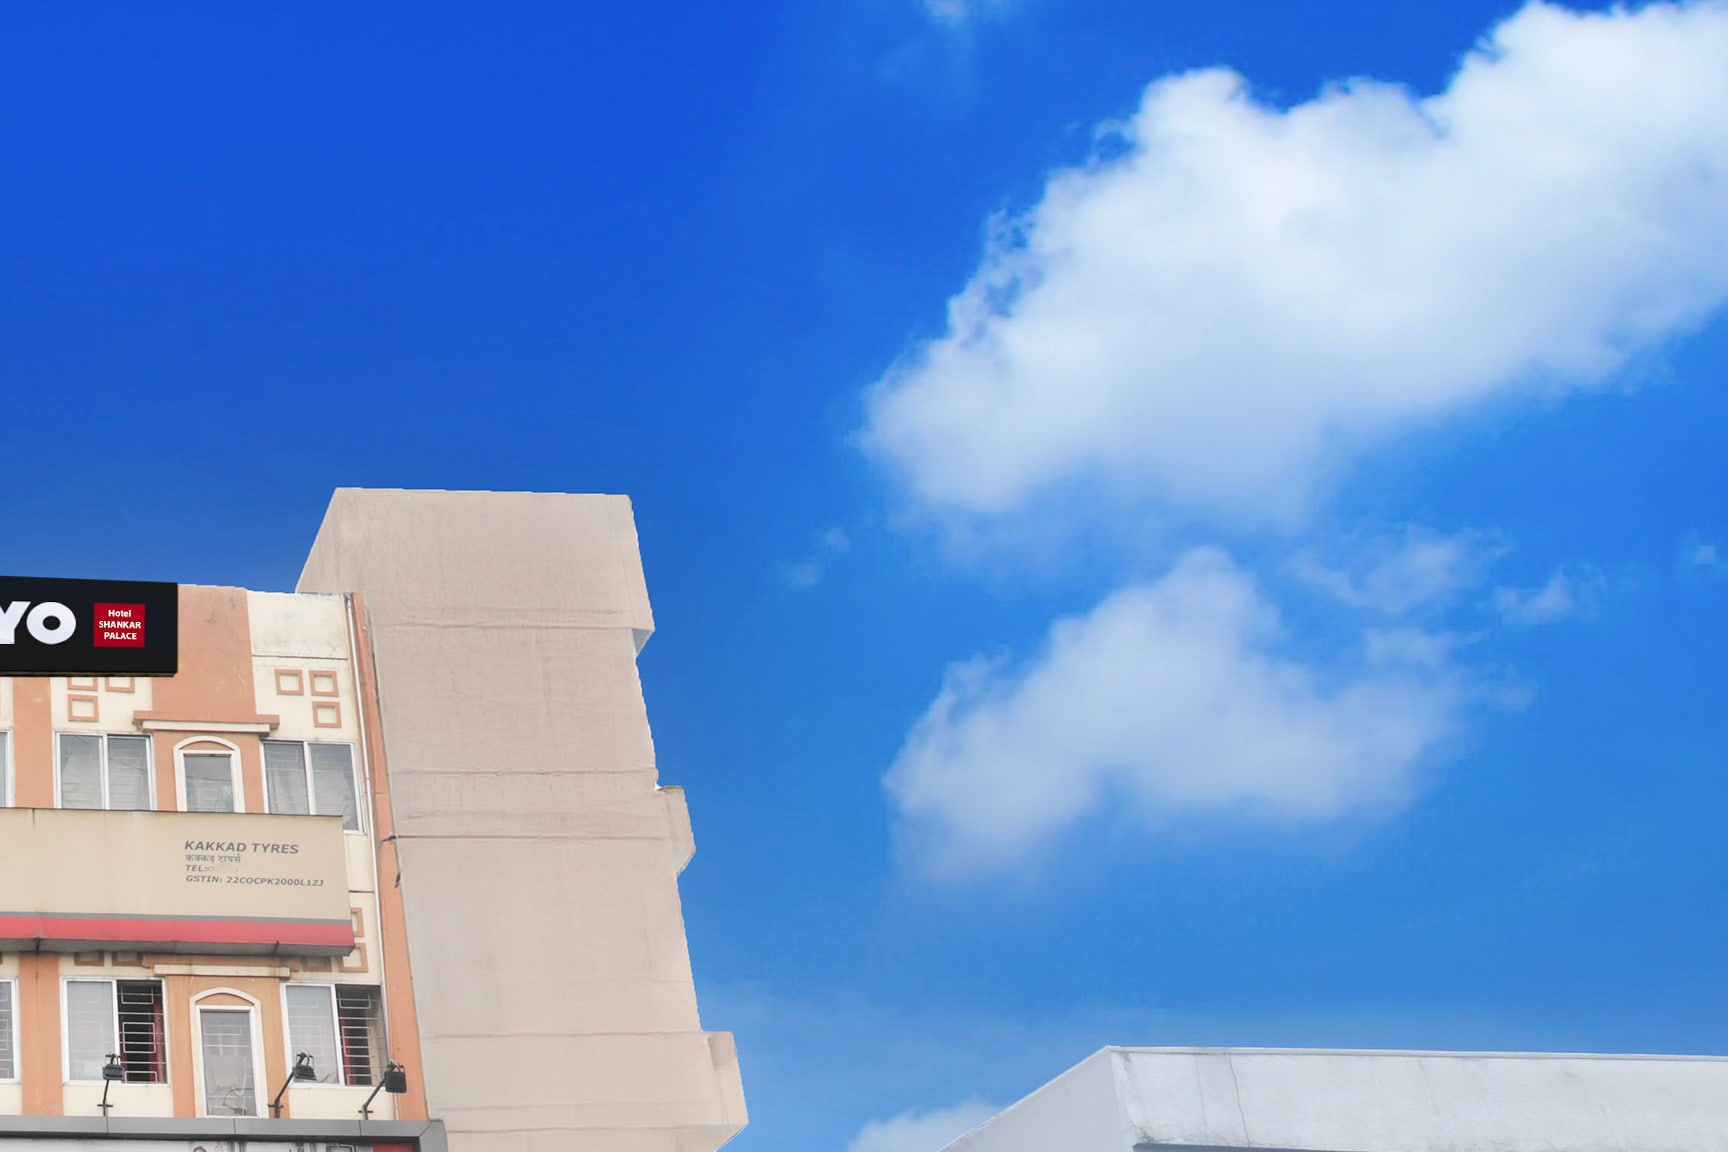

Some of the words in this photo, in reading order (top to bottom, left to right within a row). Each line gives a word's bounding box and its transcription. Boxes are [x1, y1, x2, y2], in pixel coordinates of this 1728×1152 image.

[108, 608, 132, 618] Hotel
[98, 620, 142, 630] SHANKAR
[103, 631, 137, 641] PALACE
[184, 840, 247, 852] KAKKAD
[252, 842, 300, 854] TYRES
[185, 875, 223, 884] GSTIN:
